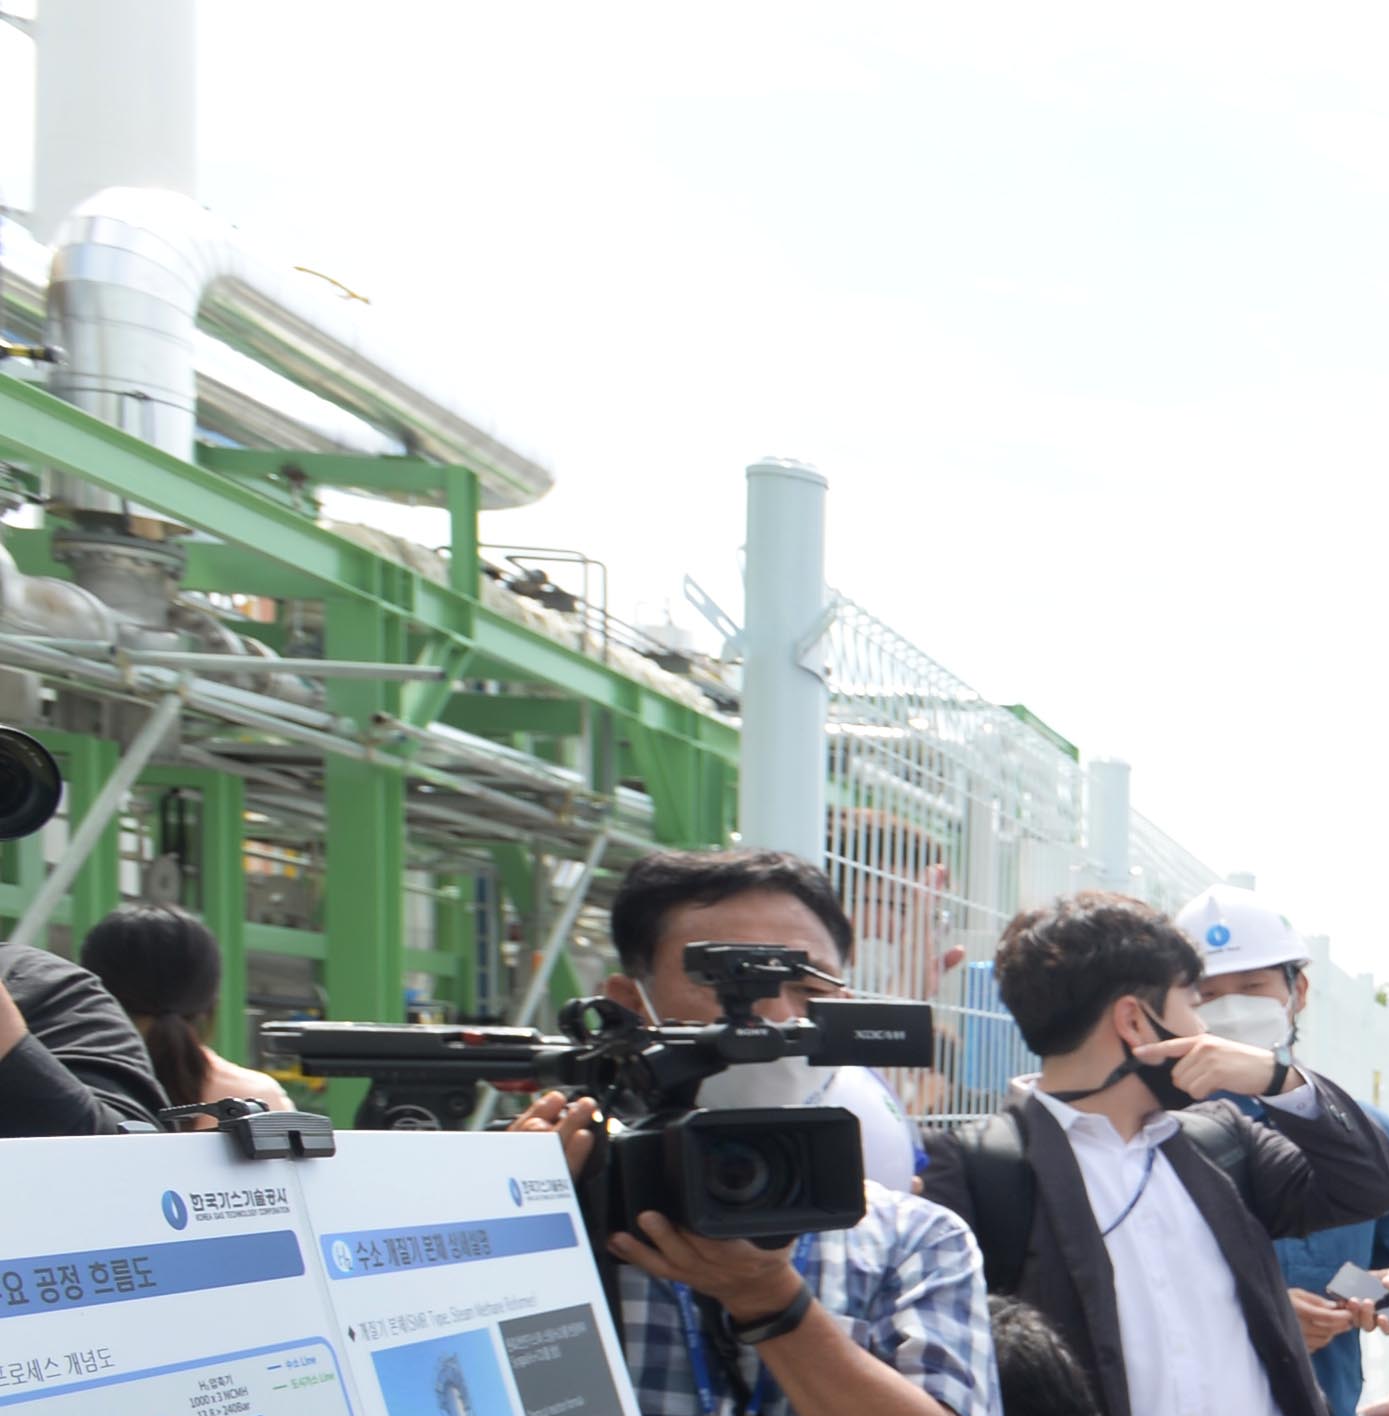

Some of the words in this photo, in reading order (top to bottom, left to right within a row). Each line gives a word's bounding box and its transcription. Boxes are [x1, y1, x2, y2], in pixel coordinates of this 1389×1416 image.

[189, 1187, 288, 1212] 한국가스기술공사
[355, 1239, 384, 1271] 수소
[0, 1271, 30, 1306] 요
[33, 1264, 84, 1304] 공정
[88, 1256, 157, 1294] 흐름도
[64, 1347, 116, 1375] 개념도
